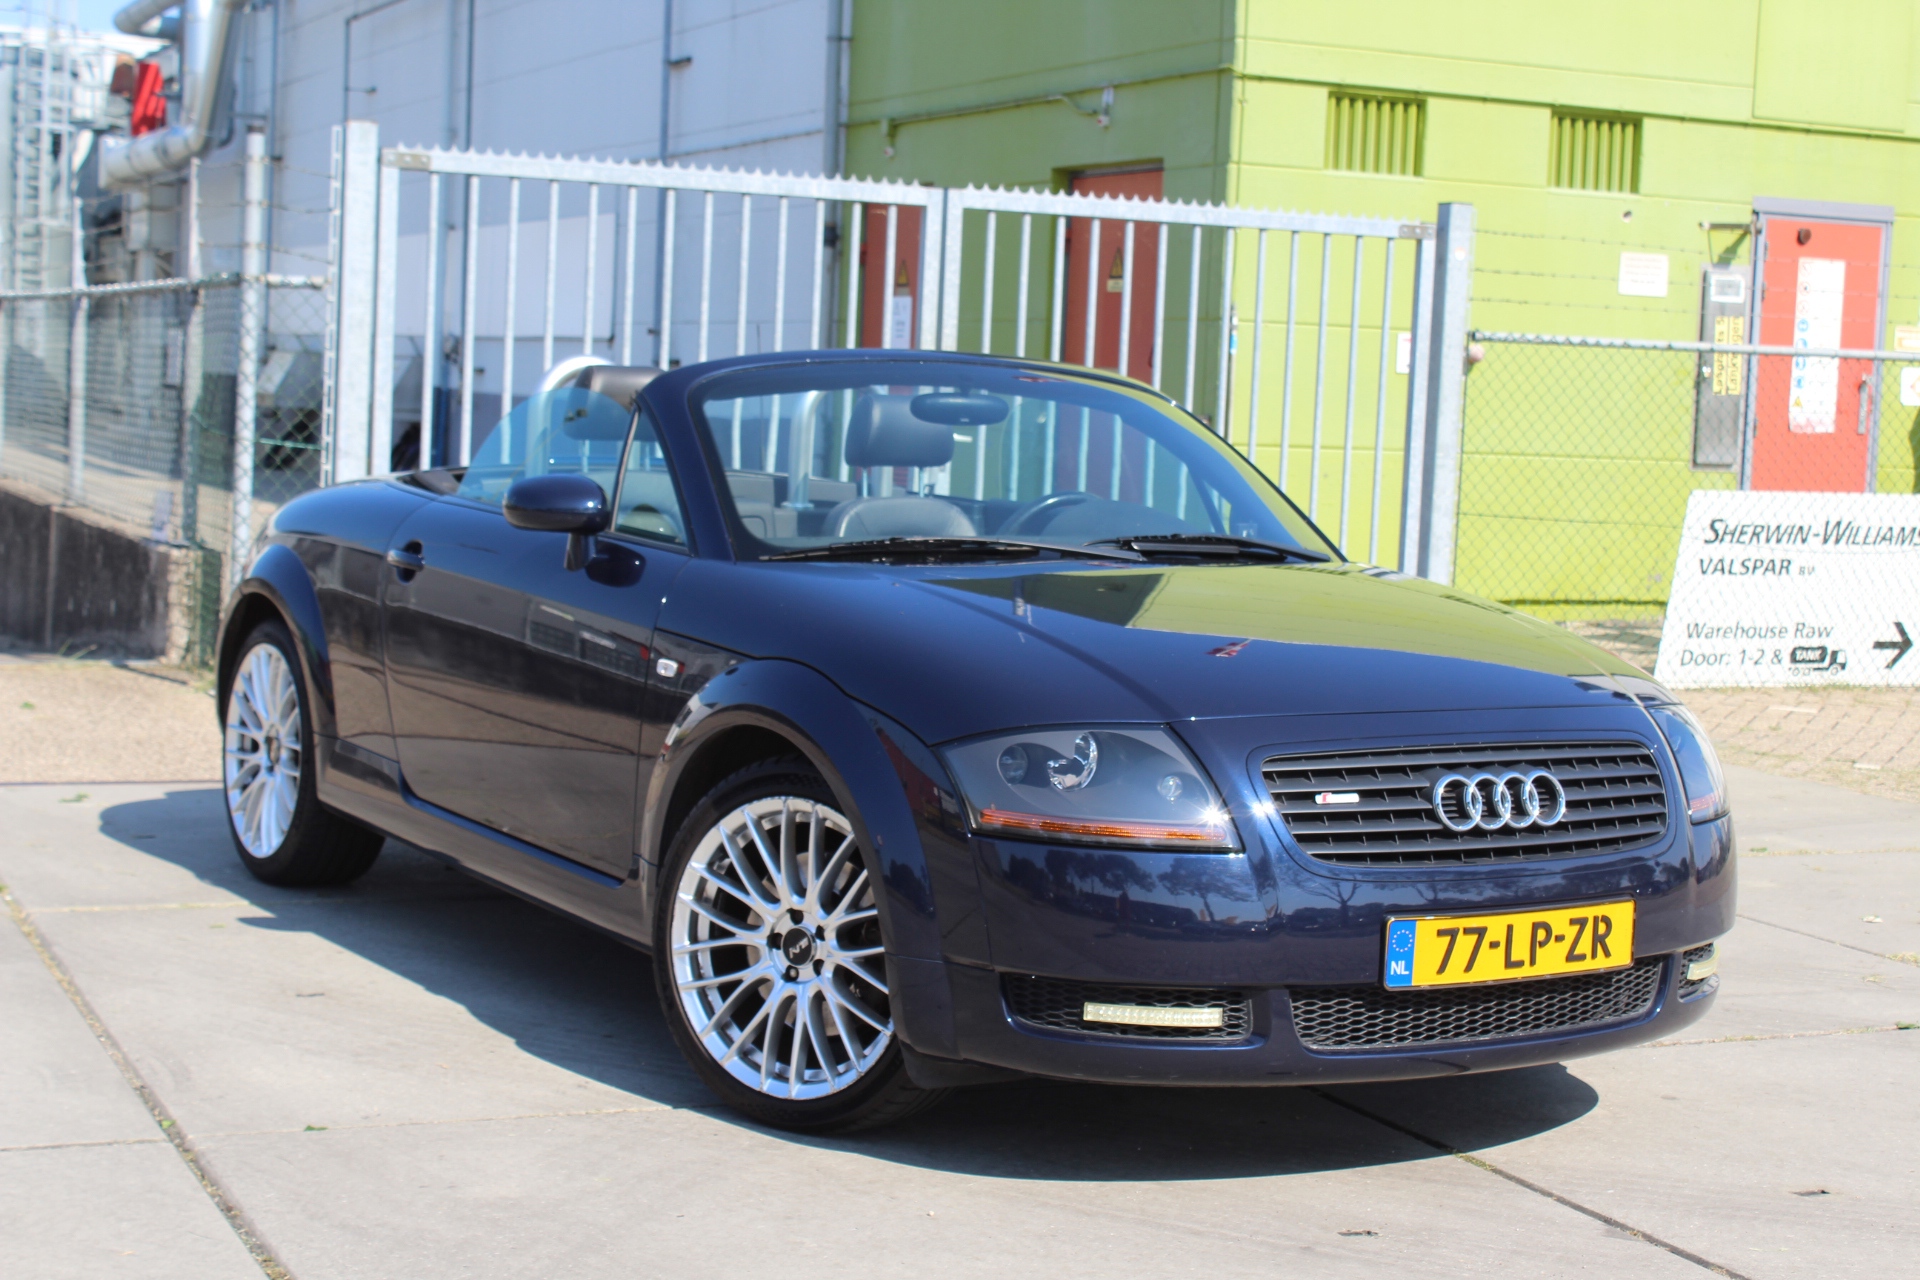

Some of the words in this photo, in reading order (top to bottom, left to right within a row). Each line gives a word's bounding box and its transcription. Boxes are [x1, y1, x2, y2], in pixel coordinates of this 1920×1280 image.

[1699, 558, 1792, 576] VALSPAR
[1686, 622, 1788, 639] Warehouse
[1794, 622, 1834, 639] Raw
[1681, 650, 1730, 667] Door:
[1740, 650, 1765, 665] 1-2
[1771, 650, 1784, 665] &
[1795, 648, 1823, 661] TANK
[1436, 915, 1613, 976] 77-LP-ZR
[1390, 960, 1410, 976] NL
